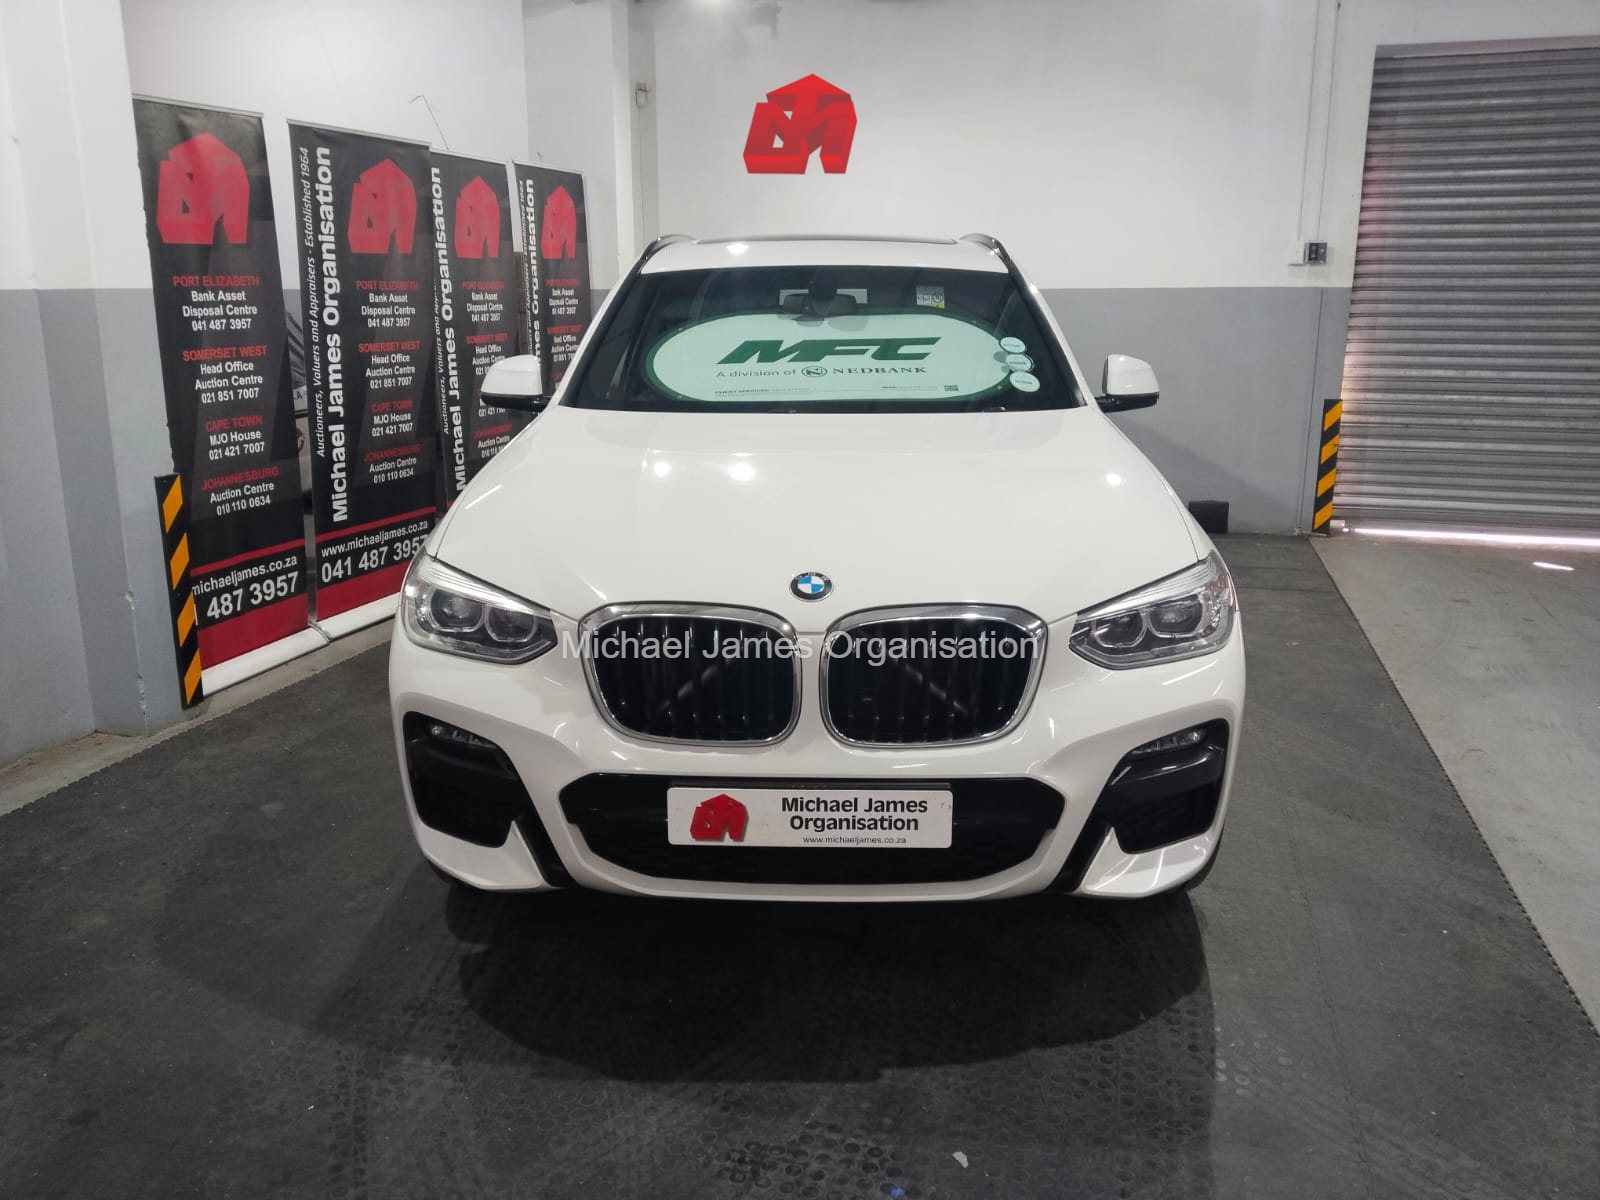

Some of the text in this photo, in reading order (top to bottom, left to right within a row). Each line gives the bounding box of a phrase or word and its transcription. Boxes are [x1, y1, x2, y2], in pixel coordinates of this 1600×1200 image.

[300, 147, 310, 177] 1964
[301, 179, 314, 248] Established
[431, 168, 454, 321] Organisation
[526, 179, 539, 314] Organisation
[173, 276, 200, 287] PORT
[306, 257, 320, 318] Appraisers
[192, 290, 246, 302] Bank Asset
[369, 292, 408, 302] Bank Asset
[182, 304, 258, 318] Disposal Centre
[361, 305, 416, 316] Disposal Centre
[192, 318, 252, 331] 041 487 3957
[368, 318, 410, 328] 041 487 3957
[310, 320, 320, 343] and
[315, 147, 348, 522] Michael James Organisation
[182, 345, 267, 362] SOMERSET WEST
[371, 354, 410, 364] Head Office
[716, 337, 942, 365] MFC
[200, 361, 254, 374] Head Office
[312, 345, 322, 386] Valuers
[366, 365, 416, 378] Auction Centre
[445, 327, 460, 400] James
[729, 369, 780, 378] division
[784, 369, 797, 377] of
[833, 367, 927, 375] NEDBANK
[195, 375, 263, 390] Auction Centre
[370, 376, 412, 389] 021 851 7007
[202, 388, 259, 404] 021 851 7007
[315, 390, 326, 458] Auctioneers,
[373, 412, 411, 425] MJO House
[372, 422, 414, 437] 021 421 7007
[210, 430, 261, 446] MJO House
[209, 442, 264, 460] 021 421 7007
[449, 406, 466, 490] Michael
[369, 457, 417, 473] Auction Centre
[374, 473, 386, 484] 010
[387, 471, 398, 482] 110
[210, 482, 274, 503] Auction Centre
[216, 495, 270, 516] 010 110 0634
[321, 520, 428, 558] www.michaeljames.co.za
[322, 556, 352, 583] 041
[358, 545, 388, 571] 487
[206, 571, 298, 618] 487 3957
[782, 797, 928, 812] Michael James
[790, 815, 919, 832] Organisation
[802, 836, 906, 846] www.michaeljames.co.za
